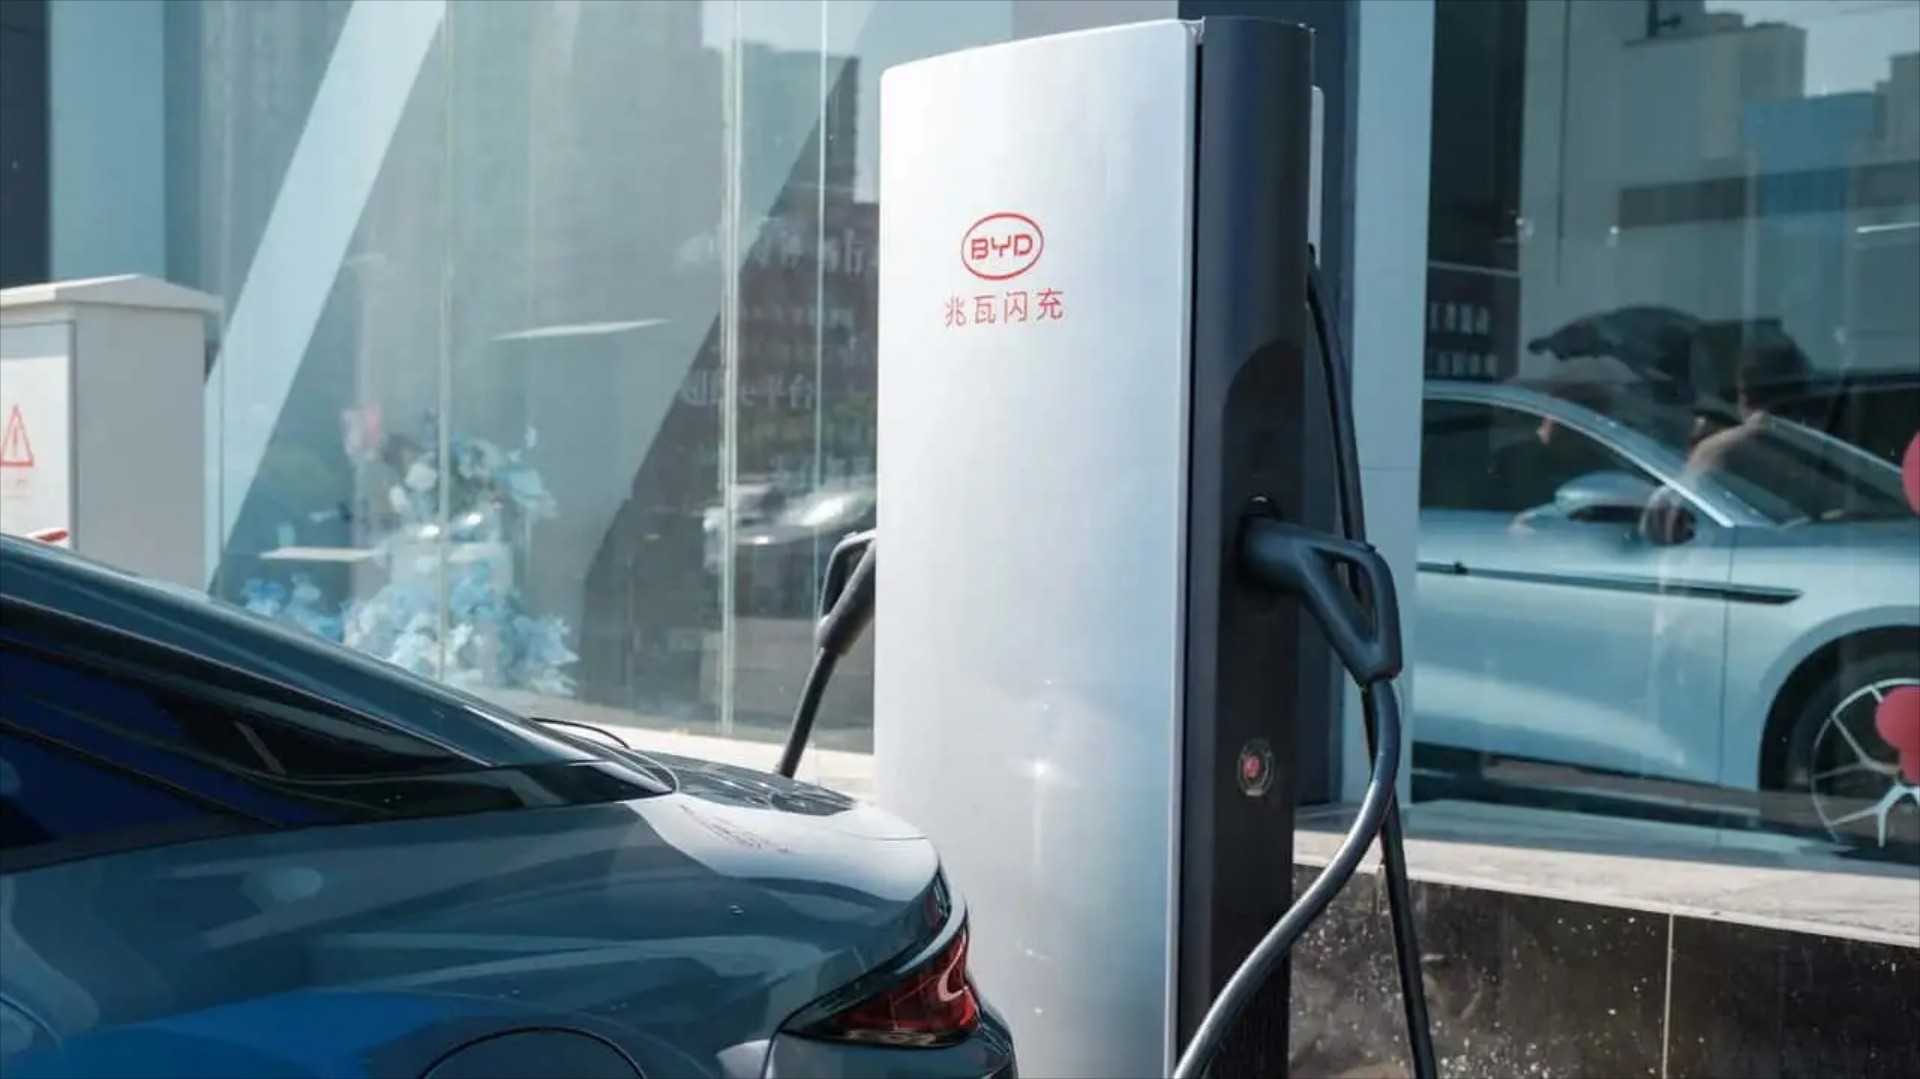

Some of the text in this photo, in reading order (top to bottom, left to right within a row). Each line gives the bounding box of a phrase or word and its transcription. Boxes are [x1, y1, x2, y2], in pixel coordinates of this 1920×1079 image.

[971, 234, 1033, 260] BYD
[944, 287, 1064, 328] 兆瓦闪充
